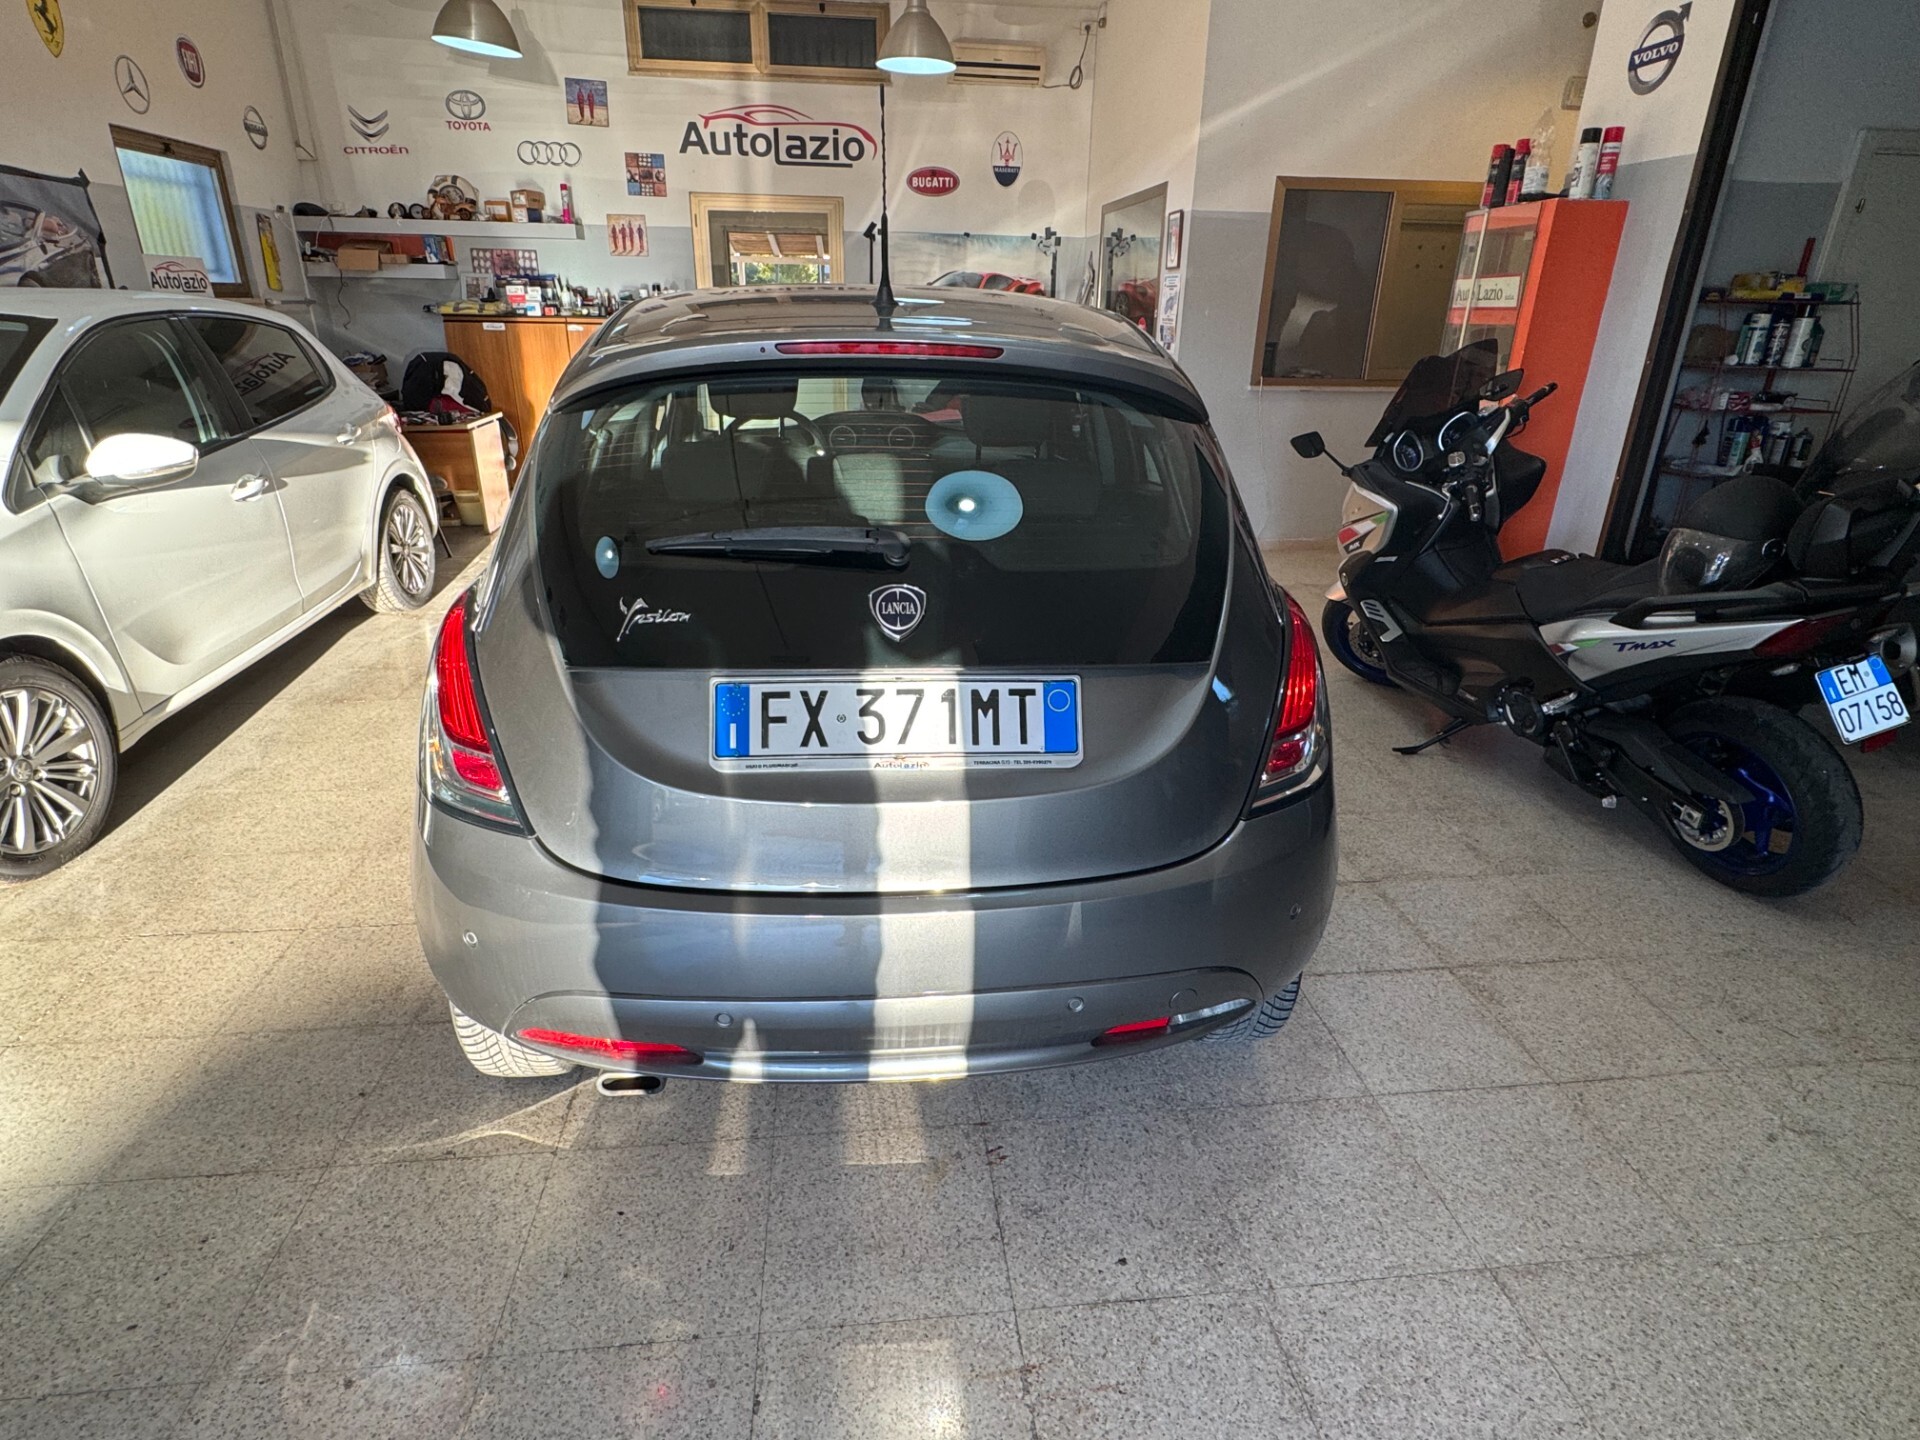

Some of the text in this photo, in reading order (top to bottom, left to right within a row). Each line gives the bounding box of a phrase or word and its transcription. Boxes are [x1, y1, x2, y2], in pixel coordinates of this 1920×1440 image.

[1633, 41, 1679, 65] VOLVO
[445, 120, 491, 131] TOYOTA
[912, 176, 954, 188] BUGATTI
[1476, 283, 1503, 302] Lazio
[881, 601, 916, 615] LANCIA
[616, 596, 691, 642] Ypsilon
[1612, 639, 1676, 652] TMAX
[1835, 664, 1867, 696] EM
[761, 688, 829, 750] FX
[1838, 691, 1904, 733] 07158
